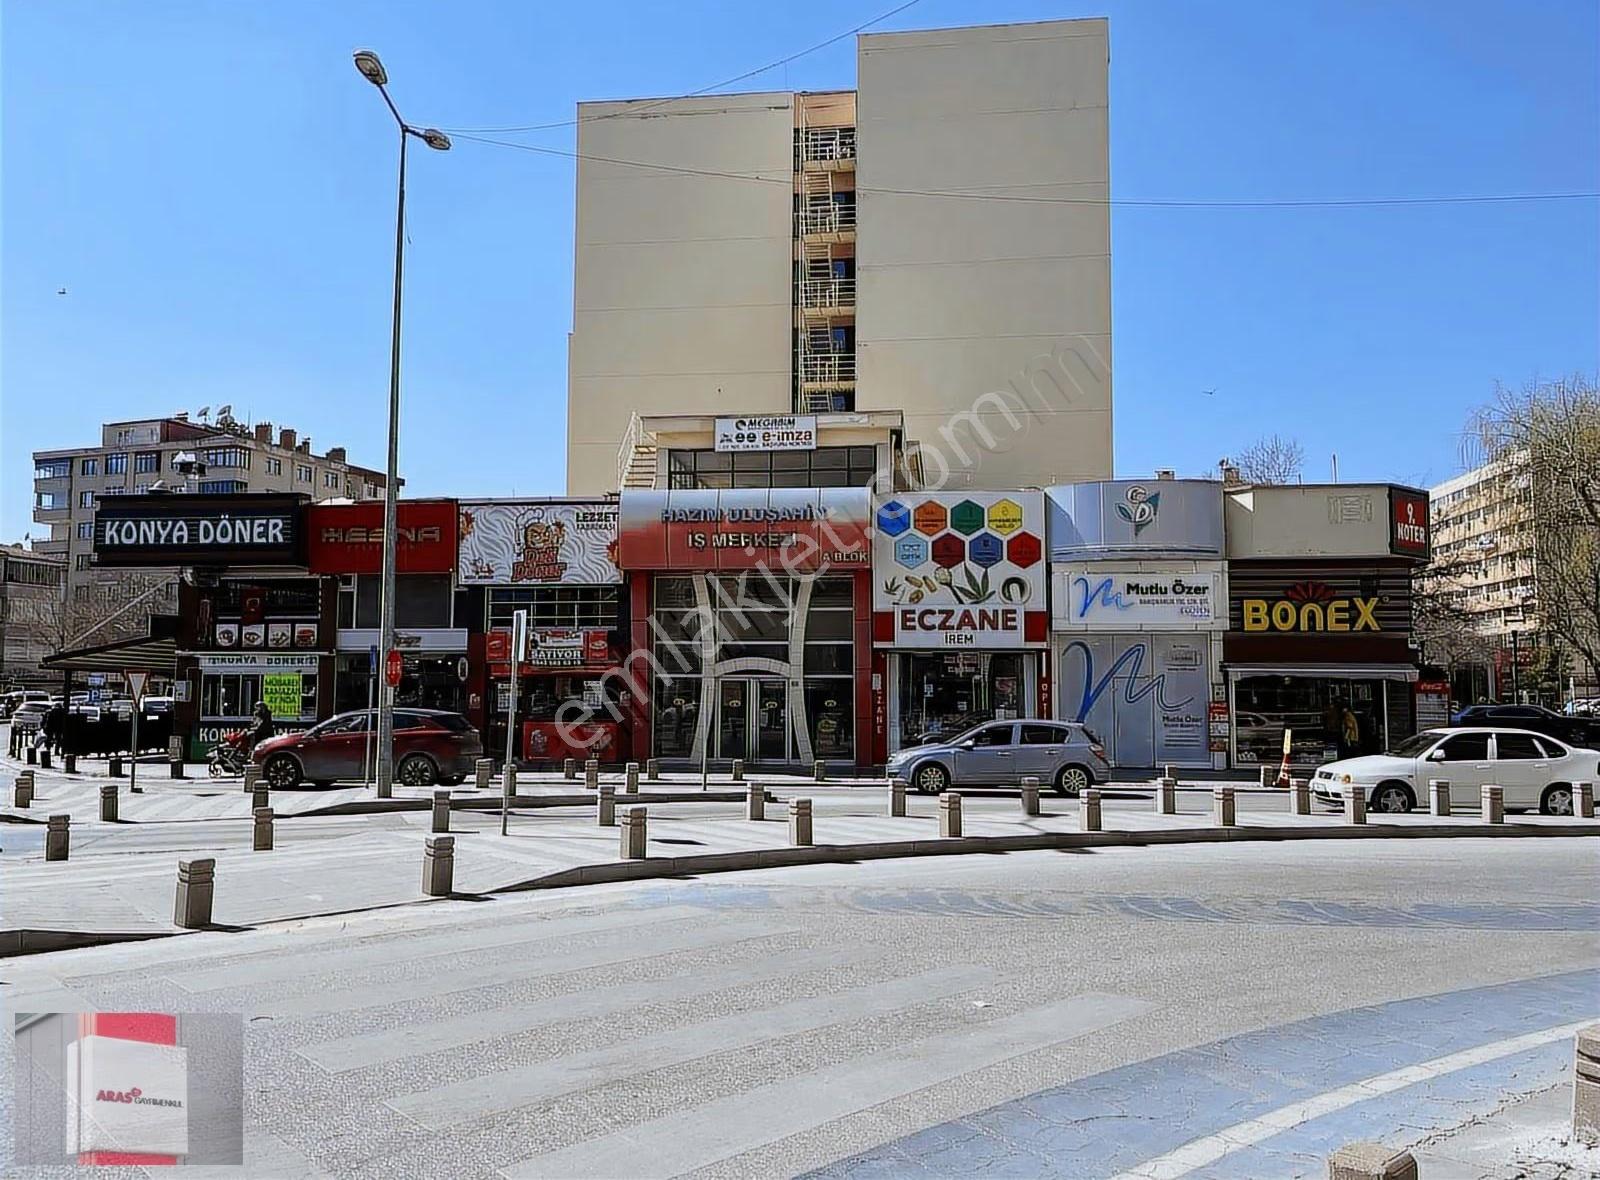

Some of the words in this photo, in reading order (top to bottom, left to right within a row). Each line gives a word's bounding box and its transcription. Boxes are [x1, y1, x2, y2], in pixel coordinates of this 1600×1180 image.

[762, 431, 812, 442] e-imza
[575, 512, 618, 523] LEZZET
[661, 508, 722, 522] HAZIM
[727, 504, 829, 524] ULUŞAHİN
[104, 520, 189, 545] KONYA
[199, 514, 284, 545] DÖNER
[1397, 523, 1426, 544] NOTER
[687, 528, 705, 551] İŞ
[711, 529, 799, 548] MERKEZİ
[822, 552, 831, 562] A
[834, 552, 868, 562] BLOK
[1126, 583, 1168, 595] Mutlu
[1172, 579, 1209, 595] Özer
[900, 608, 1018, 631] ECZANE
[944, 633, 974, 644] İREM
